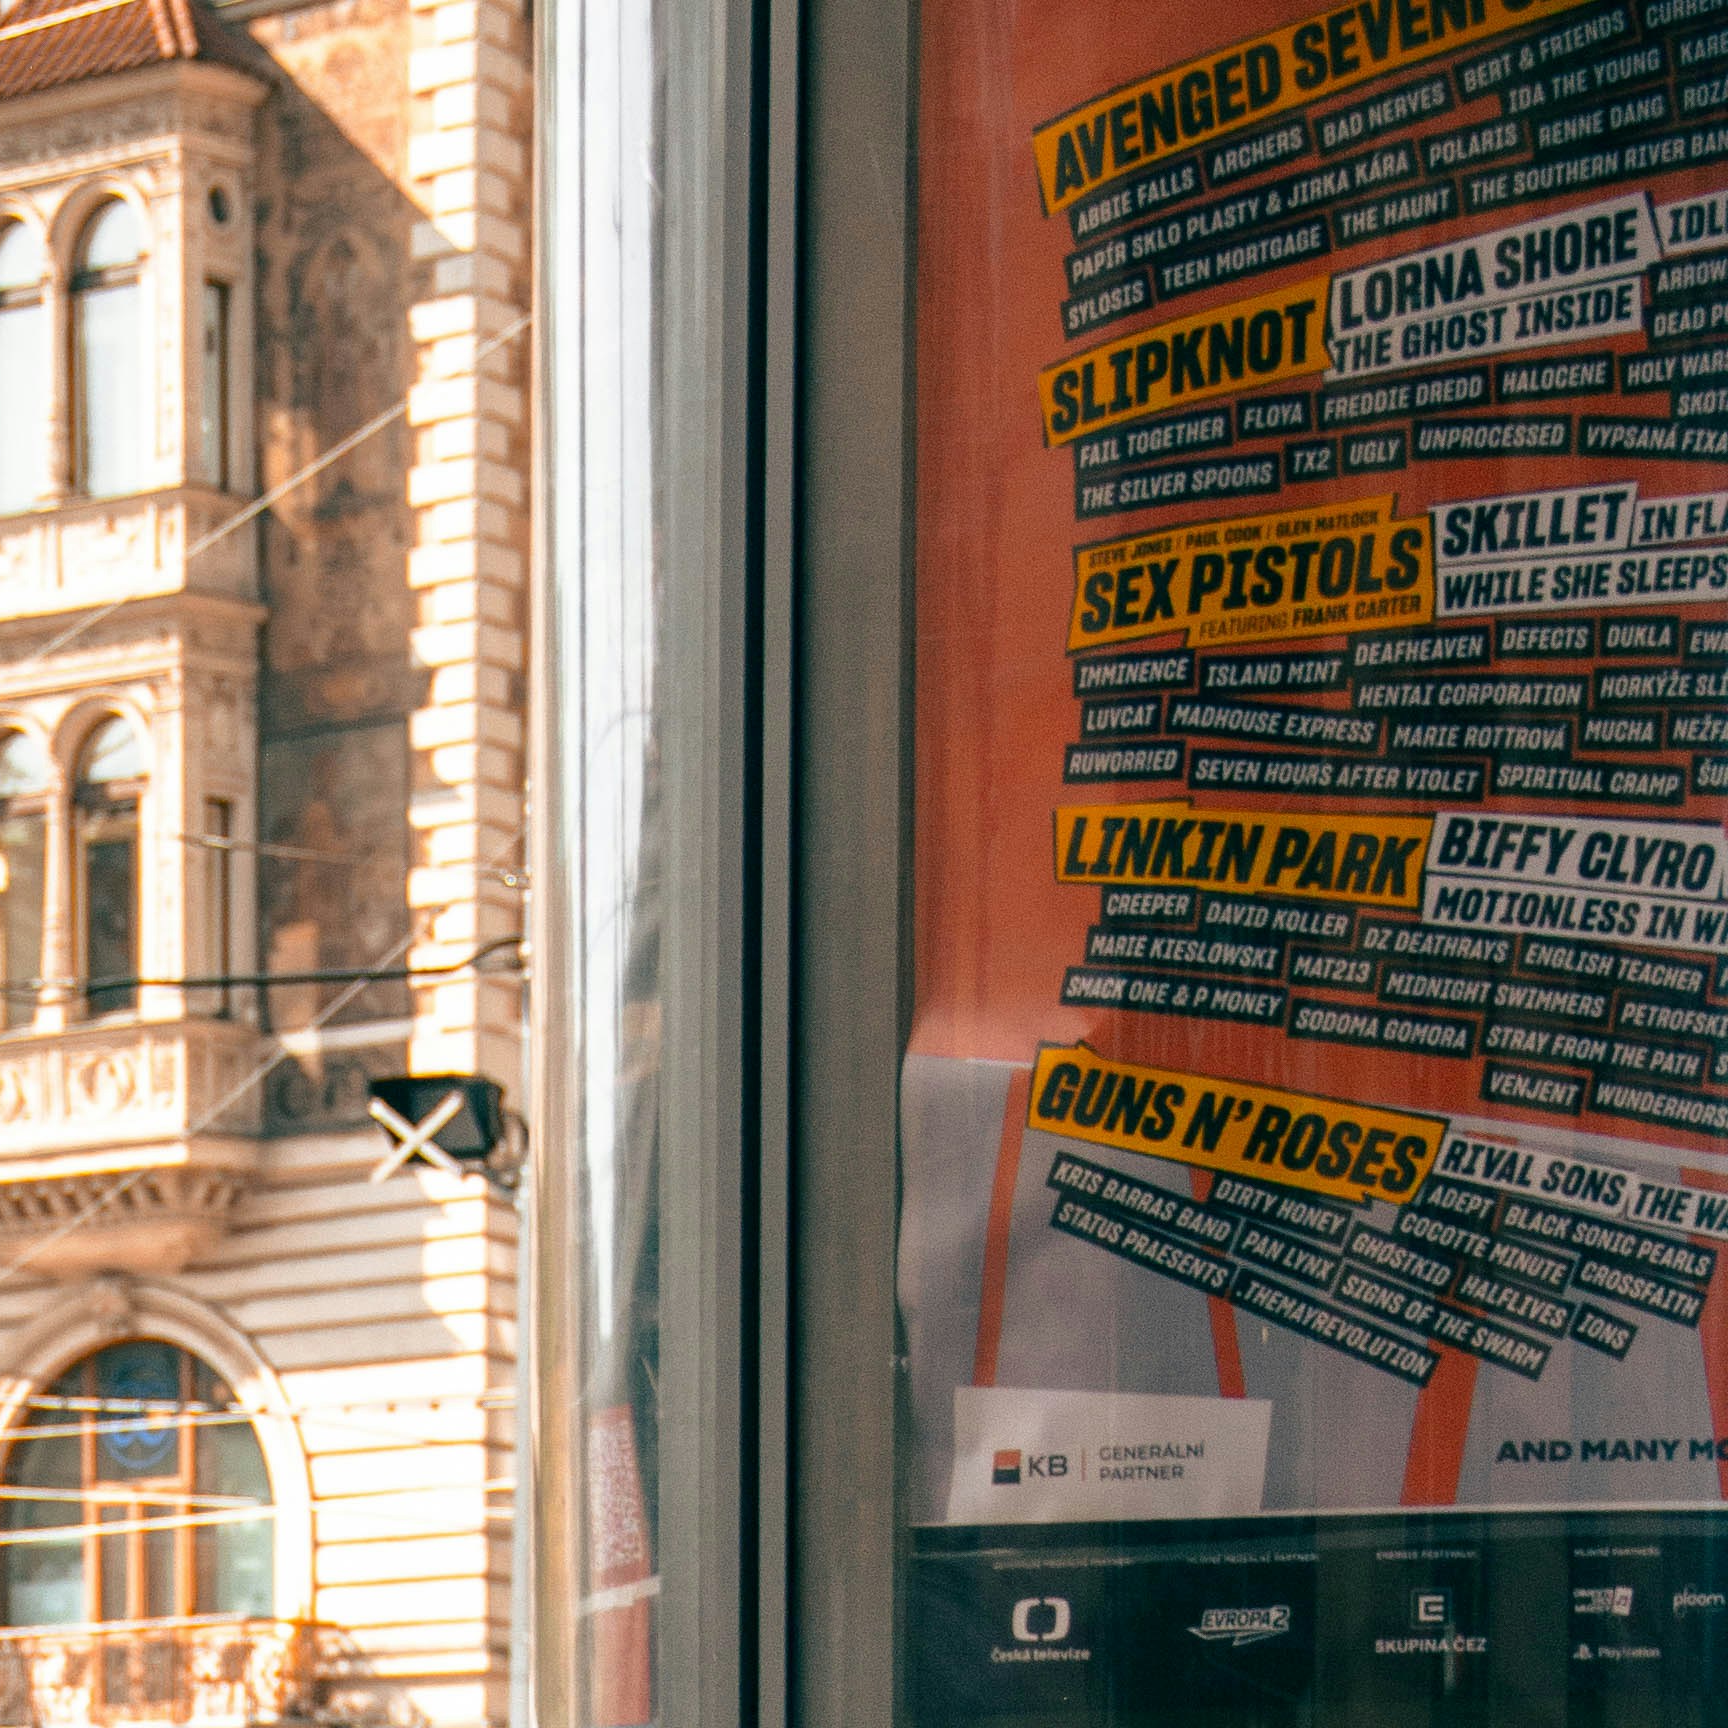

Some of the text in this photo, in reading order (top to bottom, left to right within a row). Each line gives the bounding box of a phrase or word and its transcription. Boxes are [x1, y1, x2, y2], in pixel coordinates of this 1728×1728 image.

[1464, 9, 1624, 92] BERT FRIENDS
[1552, 48, 1660, 100] THE YOUNG
[1053, 44, 1281, 201] AVENGED
[1323, 82, 1445, 148] BAD NERVES
[1610, 94, 1665, 128] DANG
[1213, 127, 1303, 179] ARCHERS
[1428, 122, 1518, 168] POLARIS
[1471, 180, 1507, 207] THE
[1513, 154, 1618, 195] SOUTHERN
[1624, 136, 1685, 170] RIVER
[1077, 166, 1195, 236] ABBIE FALLS
[1131, 169, 1350, 260] SKLO PLASTY JIRKA
[1383, 188, 1450, 228] HAUNT
[1162, 225, 1321, 291] TEEN MORTGAGE
[1341, 208, 1638, 331] LORNA SHORE
[1068, 280, 1144, 330] SYLOSIS
[1336, 284, 1633, 375] THE GHOST INSIDE
[1050, 300, 1316, 435] SLIPKNOT
[1502, 360, 1607, 394] HALOCENE
[1627, 356, 1676, 387] HOLY
[1243, 403, 1304, 430] FLOYA
[1324, 375, 1484, 422] FREDDIE DREDD
[1079, 416, 1224, 468] FAIL TOGETHER
[1349, 437, 1400, 466] UGLY
[1419, 423, 1567, 451] UNPROCESSED
[1293, 448, 1330, 474] TX2
[1081, 464, 1273, 511] THE SILVER SPOONS
[1442, 492, 1628, 557] SKILLET
[1639, 504, 1678, 541] IN
[1081, 527, 1423, 634] SEX PISTOLS
[1444, 553, 1727, 610] WHILE SHE SLEEPS
[1354, 636, 1484, 667] DEAFHEAVEN
[1502, 627, 1589, 650] DEFECTS
[1606, 625, 1672, 648] DUKLA
[1078, 658, 1189, 688] IMMINENCE
[1205, 660, 1342, 688] ISLAND MINT
[1357, 683, 1582, 708] HENTAI CORPORATION
[1086, 704, 1156, 731] LUVCAT
[1172, 705, 1376, 743] MADHOUSE EXPRESS
[1393, 725, 1459, 748] MARIE
[1585, 720, 1655, 742] MUCHA
[1195, 760, 1478, 793] SEVEN HOURS AFTER VIOLET
[1496, 765, 1680, 797] SPIRITUAL CRAMP
[1064, 817, 1422, 896] LINKIN PARK
[1438, 817, 1716, 892] BIFFY CLYRO
[1106, 893, 1190, 916] CREEPER
[1205, 902, 1350, 939] DAVID KOLLER
[1433, 886, 1687, 943] MOTIONLESS IN
[1090, 935, 1278, 971] MARIE KIESLOWSKI
[1293, 955, 1372, 983] MAT213
[1395, 932, 1509, 963] DEATHRAYS
[1524, 943, 1703, 993] ENGLISH TEACHER
[1066, 975, 1281, 1016] SMACK ONE MONEY
[1385, 973, 1606, 1018] MIDNIGHT SWIMMERS
[1295, 1007, 1468, 1049] SODOMA GOMORA
[1486, 1025, 1700, 1078] STRAY FROM THE PATH
[1489, 1071, 1579, 1106] VENJENT
[1037, 1063, 1185, 1140] GUNS
[1242, 1104, 1428, 1194] ROSES
[1442, 1140, 1626, 1208] RIVAL SONS
[1054, 1164, 1232, 1241] KRIS BARRAS BAND
[1216, 1180, 1345, 1233] DIRTY HONEY
[1427, 1185, 1494, 1218] ADEPT
[1635, 1183, 1693, 1223] THE
[1058, 1202, 1229, 1289] STATUS PRAESENTS
[1242, 1231, 1335, 1281] PAN LYNX
[1399, 1213, 1569, 1286] COCOTTE MINUTE
[1504, 1206, 1712, 1277] BLACK SONIC PEARLS
[1460, 1276, 1569, 1329] HALFLIVES
[1579, 1261, 1700, 1320] CROSSFAITH
[1341, 1274, 1545, 1372] SIGNS THE SWARM
[1576, 1313, 1631, 1351] IONS
[1028, 1454, 1068, 1478] KB
[1496, 1439, 1679, 1463] AND MANY
